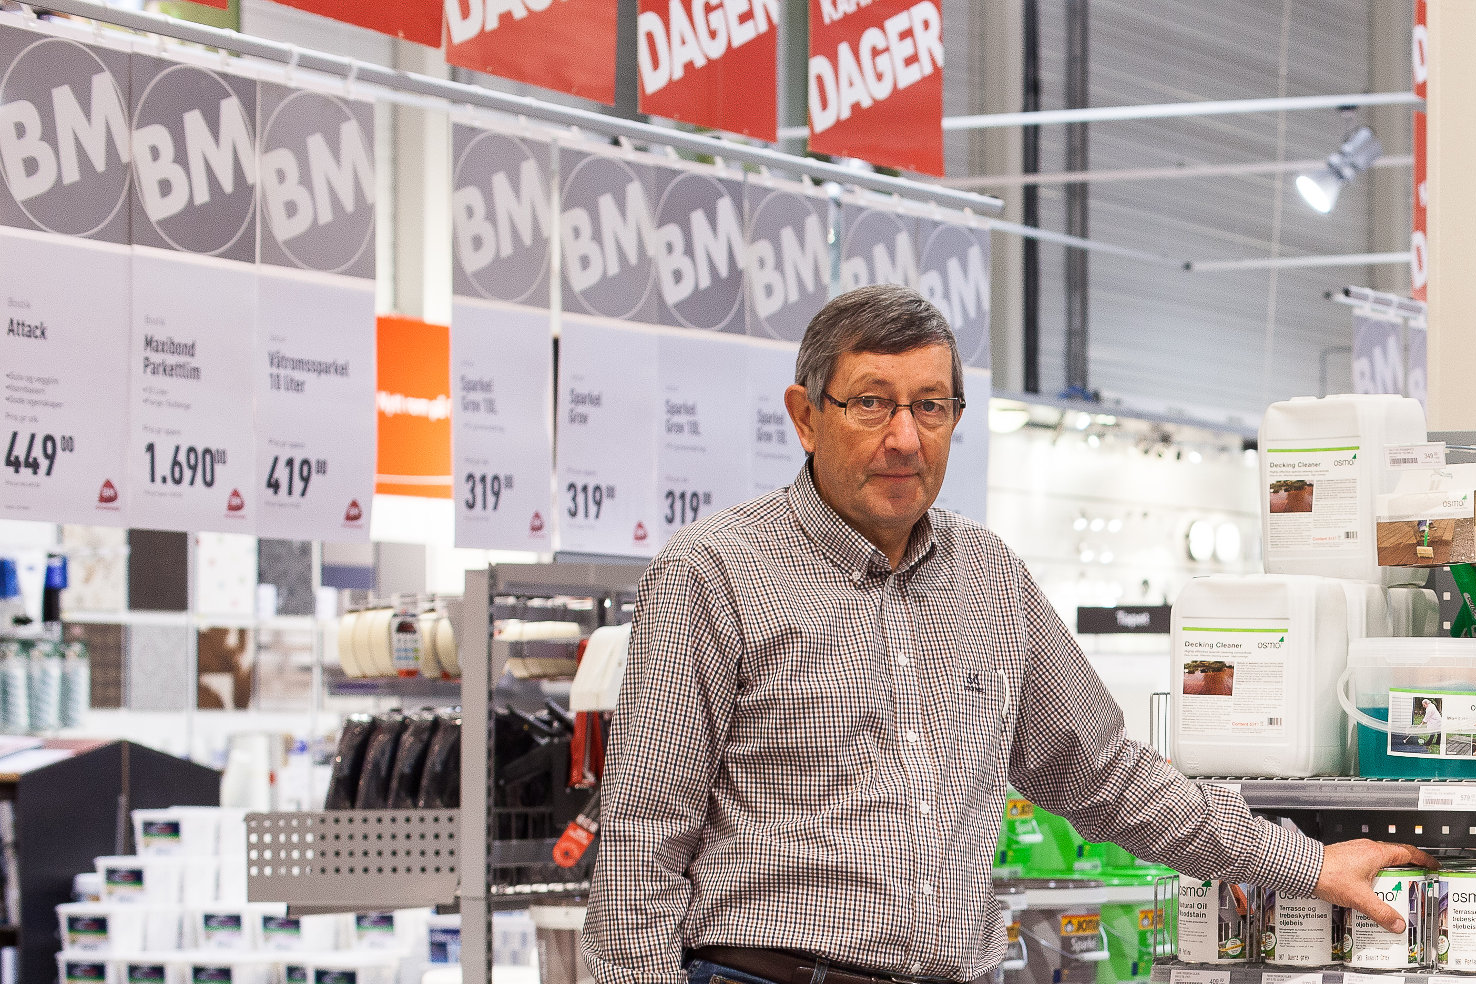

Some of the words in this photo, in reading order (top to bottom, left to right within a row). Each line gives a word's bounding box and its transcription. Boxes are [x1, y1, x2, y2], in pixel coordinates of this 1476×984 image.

[808, 1, 944, 133] DAGER
[0, 72, 130, 201] BM
[134, 96, 254, 222] BM
[263, 119, 374, 242] BM
[453, 158, 552, 274] BM
[560, 181, 656, 292] BM
[656, 197, 746, 306] BM
[746, 215, 829, 320] BM
[7, 318, 47, 339] Attack
[143, 334, 196, 357] Maxibond
[143, 357, 201, 380] Parkettlim
[5, 431, 57, 476] 449
[145, 442, 215, 487] 1.690
[1334, 459, 1354, 467] osmo
[266, 455, 312, 497] 419
[465, 472, 501, 511] 319
[567, 482, 602, 520] 319
[665, 490, 699, 525] 319
[1185, 641, 1214, 650] Decking
[1216, 641, 1243, 649] Cleaner
[1257, 642, 1282, 650] osmo
[1279, 912, 1328, 920] trebeskyttelses
[1279, 919, 1303, 927] oljebeis
[1308, 906, 1317, 914] og
